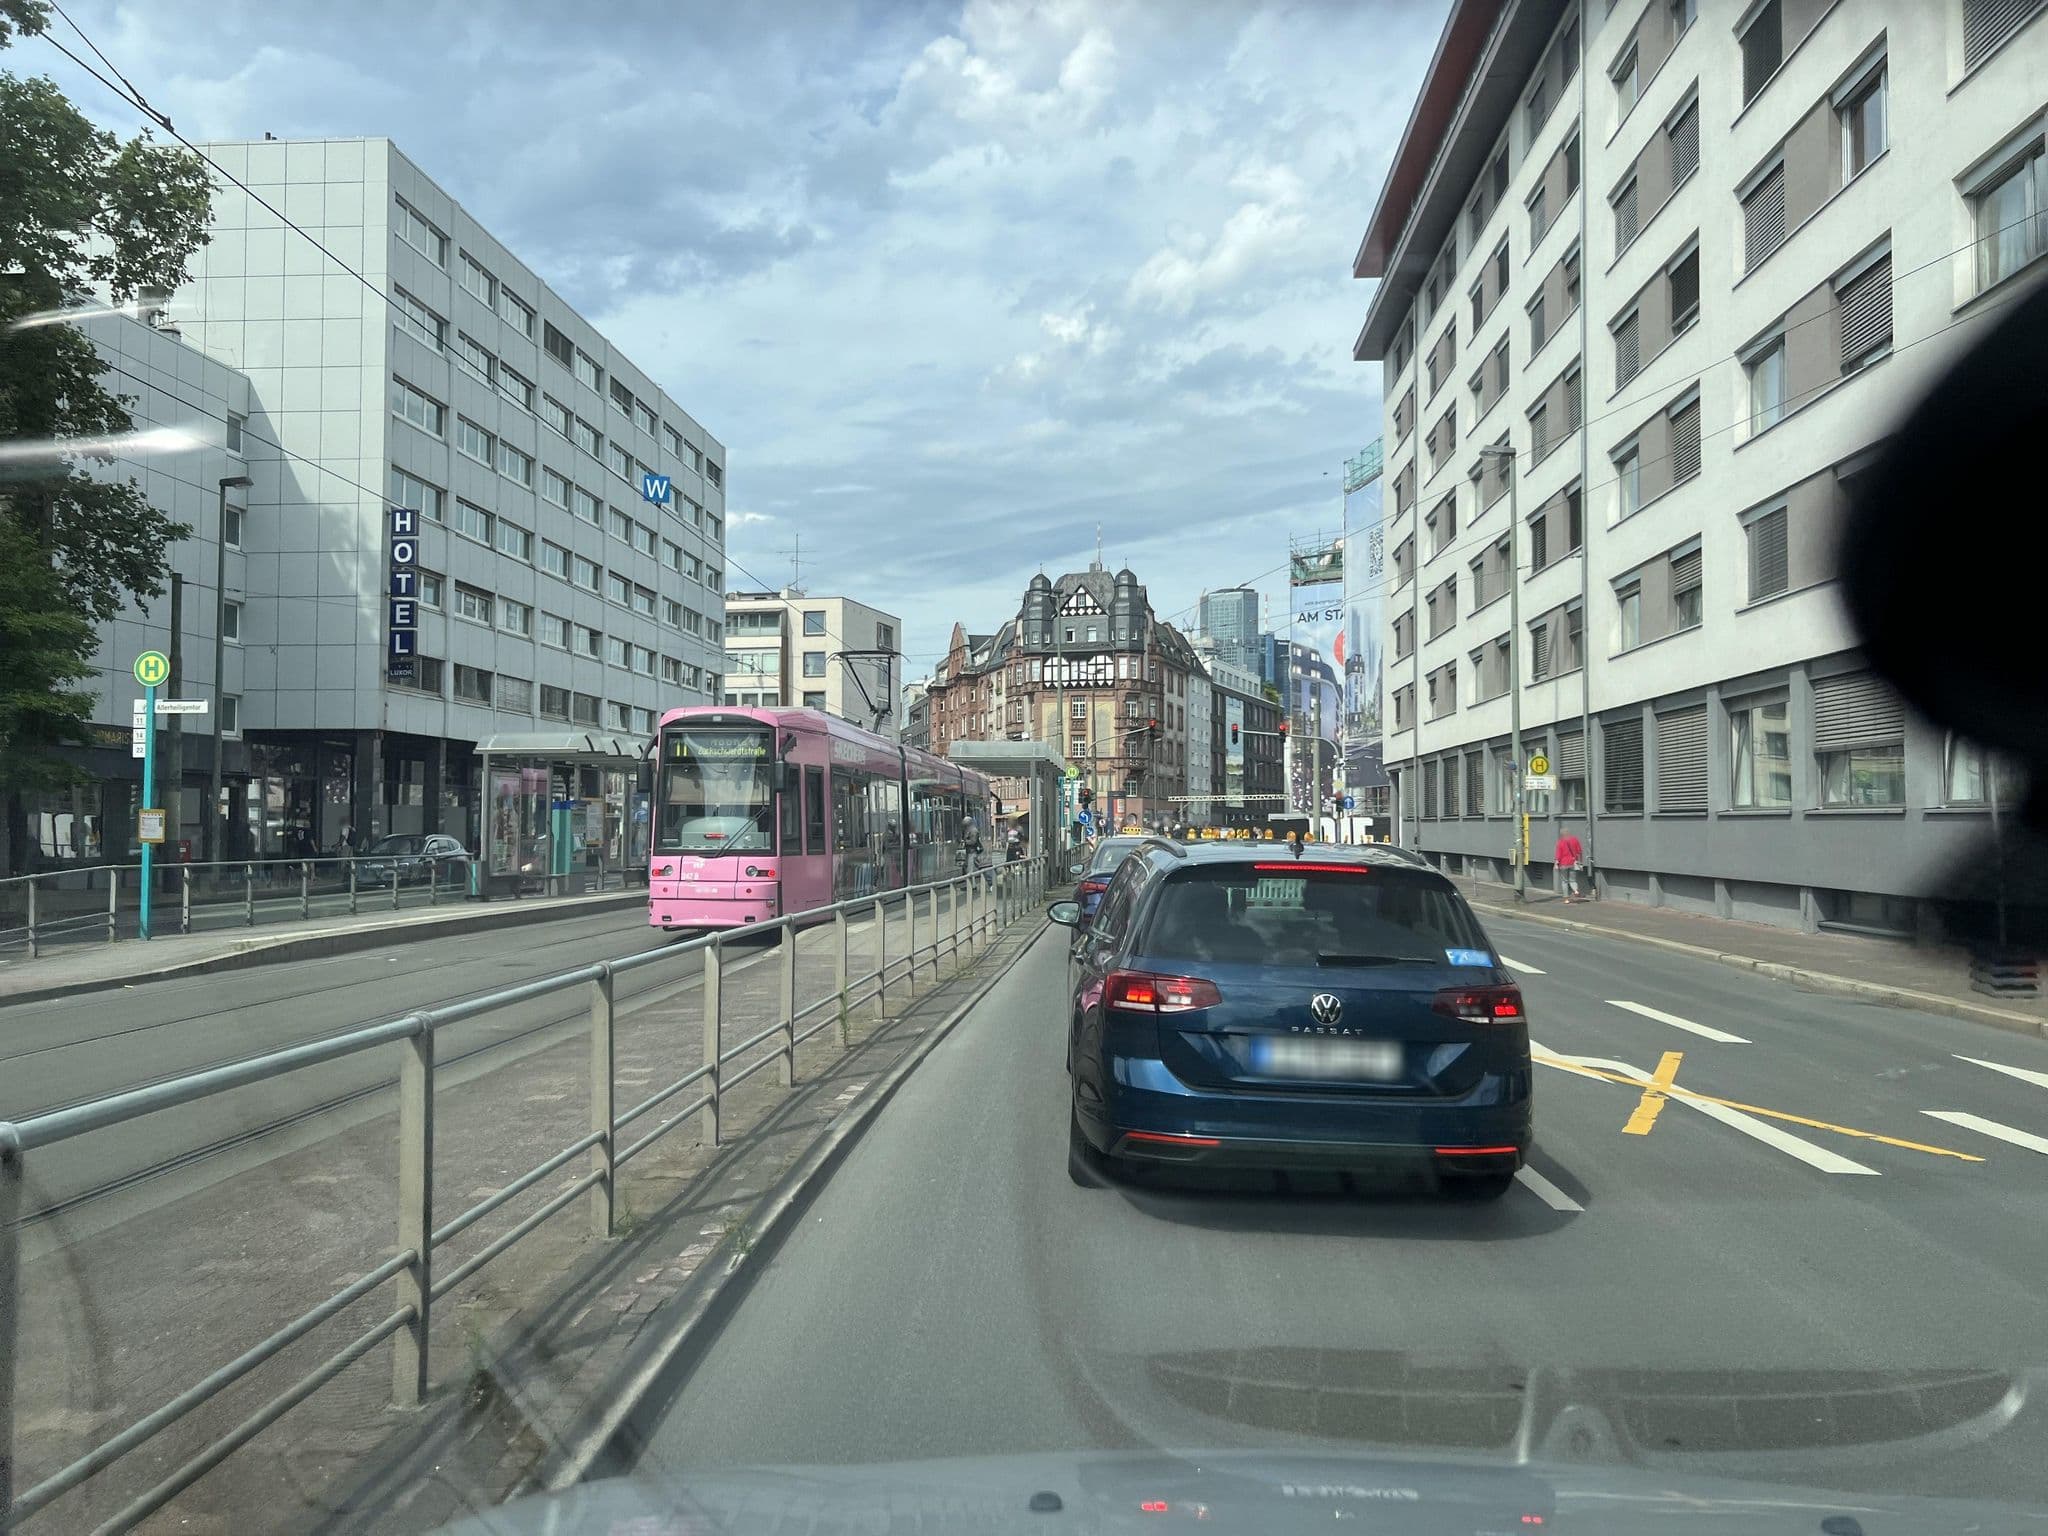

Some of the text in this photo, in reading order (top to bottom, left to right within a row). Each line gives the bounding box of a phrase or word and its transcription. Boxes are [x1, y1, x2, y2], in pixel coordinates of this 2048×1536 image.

[646, 479, 668, 499] W
[394, 512, 413, 654] HOTEL
[1297, 611, 1319, 623] AM
[144, 660, 160, 678] H
[676, 742, 688, 757] 11
[1535, 760, 1544, 771] H
[1291, 1026, 1363, 1036] PASSAT
